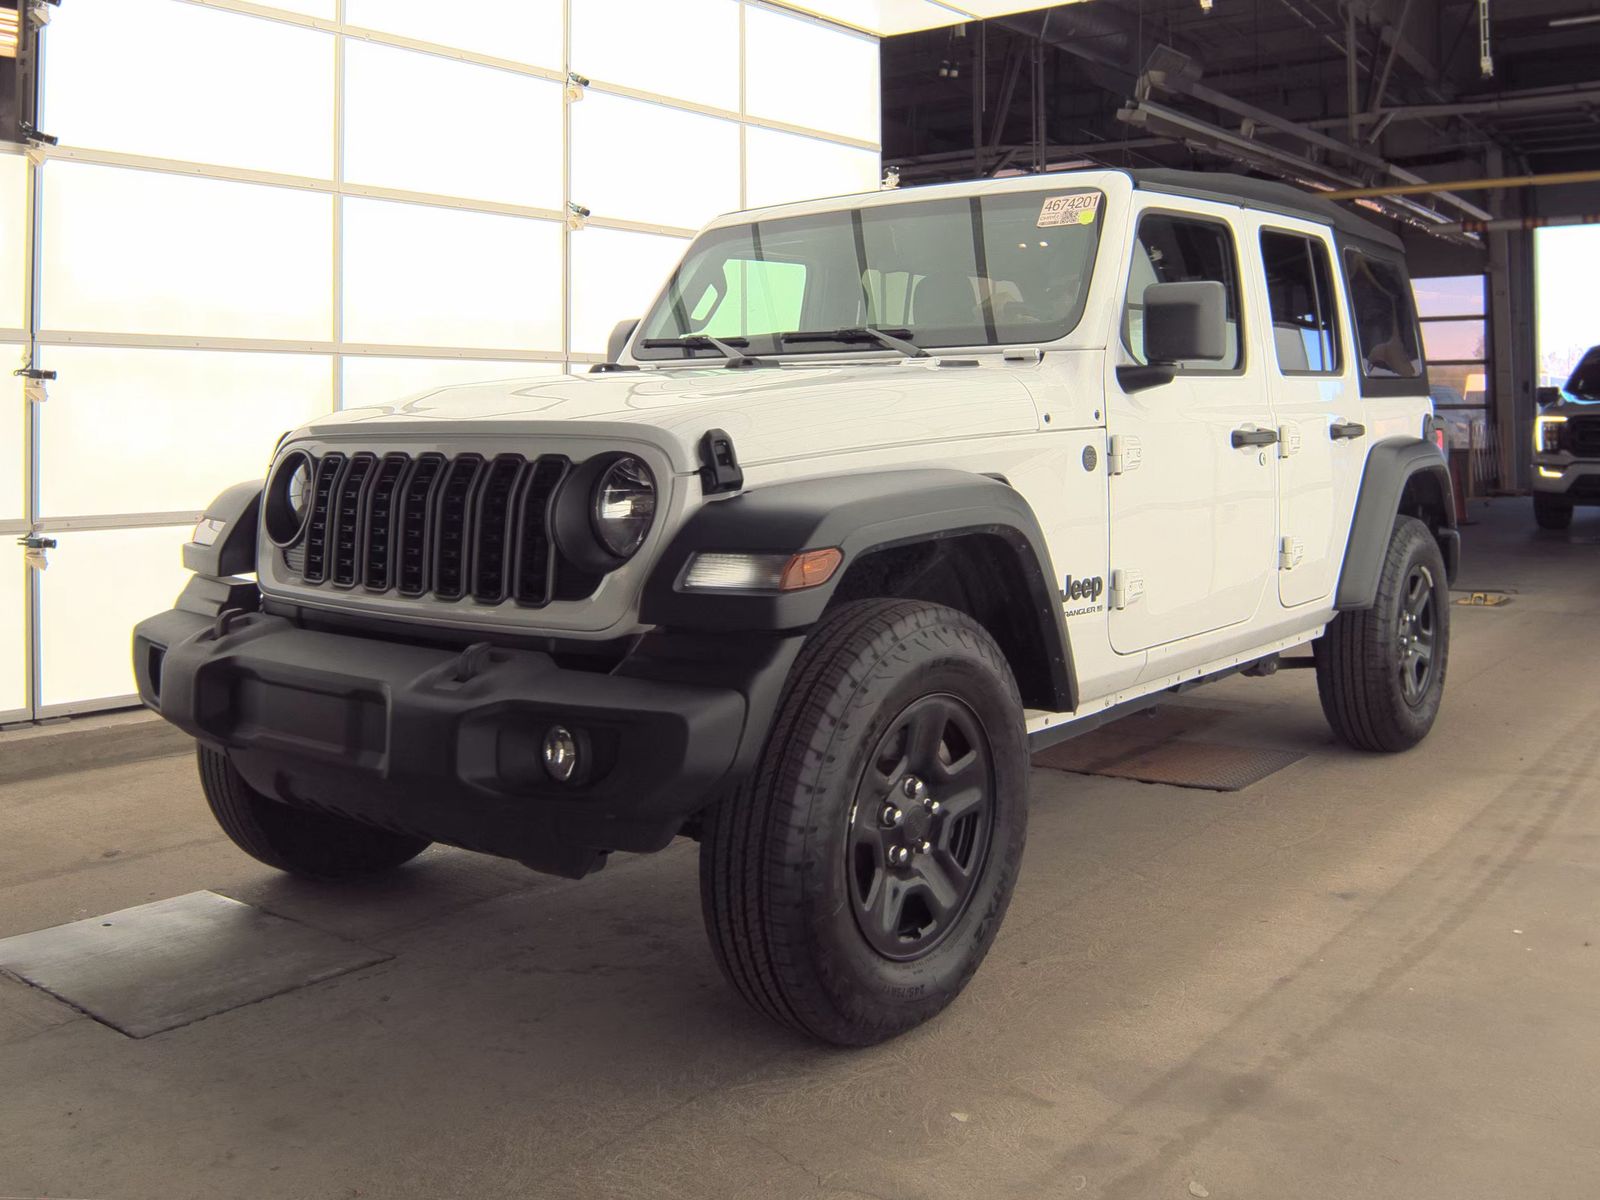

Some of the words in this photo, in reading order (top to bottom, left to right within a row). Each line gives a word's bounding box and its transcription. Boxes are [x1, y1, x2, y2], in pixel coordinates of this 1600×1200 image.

[1044, 195, 1099, 211] 4674201
[1059, 574, 1103, 602] Jeep
[1063, 606, 1096, 617] RANGLER
